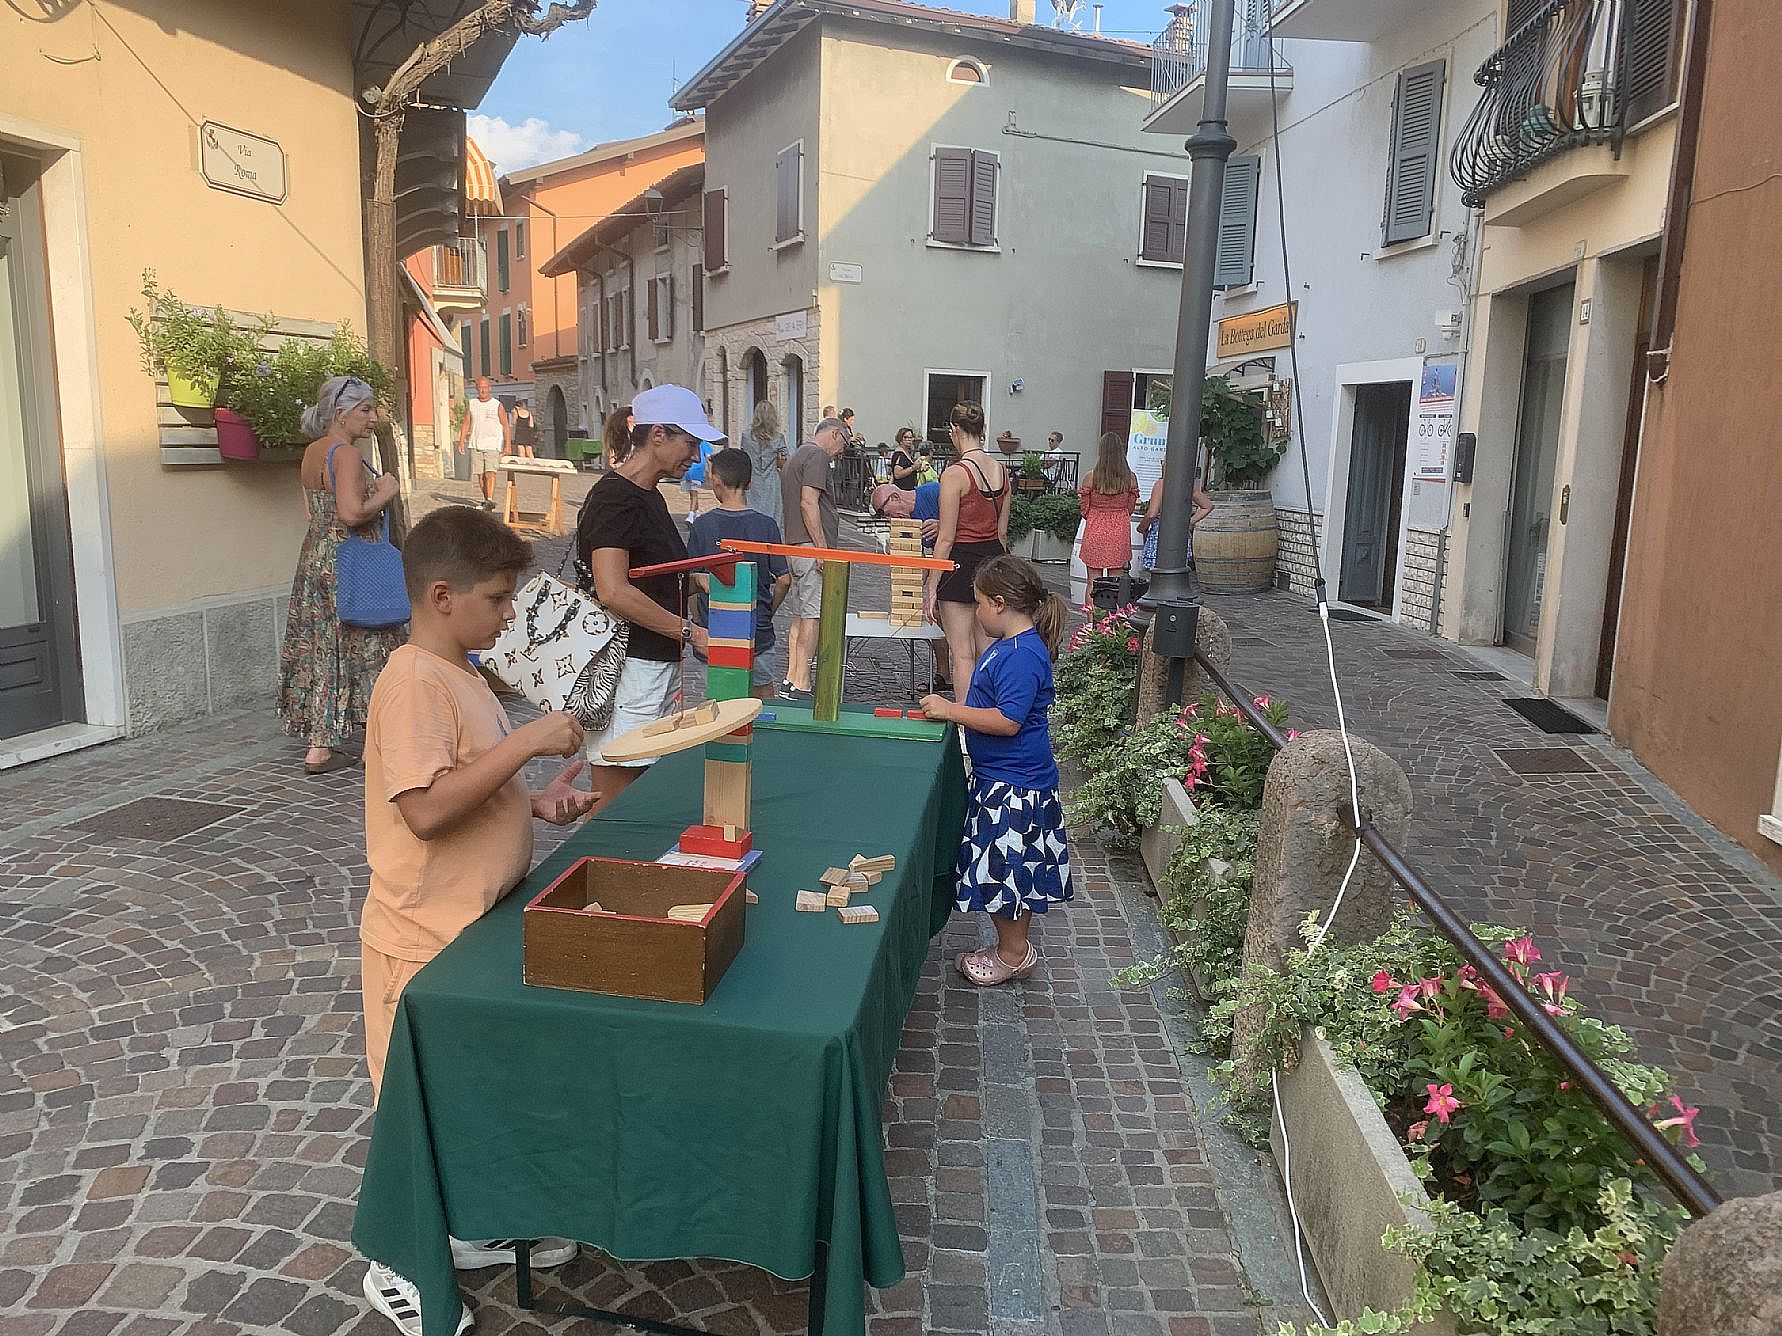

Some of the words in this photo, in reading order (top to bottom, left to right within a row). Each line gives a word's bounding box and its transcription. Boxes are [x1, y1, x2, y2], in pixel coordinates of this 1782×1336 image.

[237, 145, 253, 157] Via
[234, 163, 257, 180] Roma
[1220, 329, 1229, 346] La
[1230, 327, 1255, 345] Bottega
[1255, 320, 1266, 340] del
[1267, 316, 1289, 337] Garda
